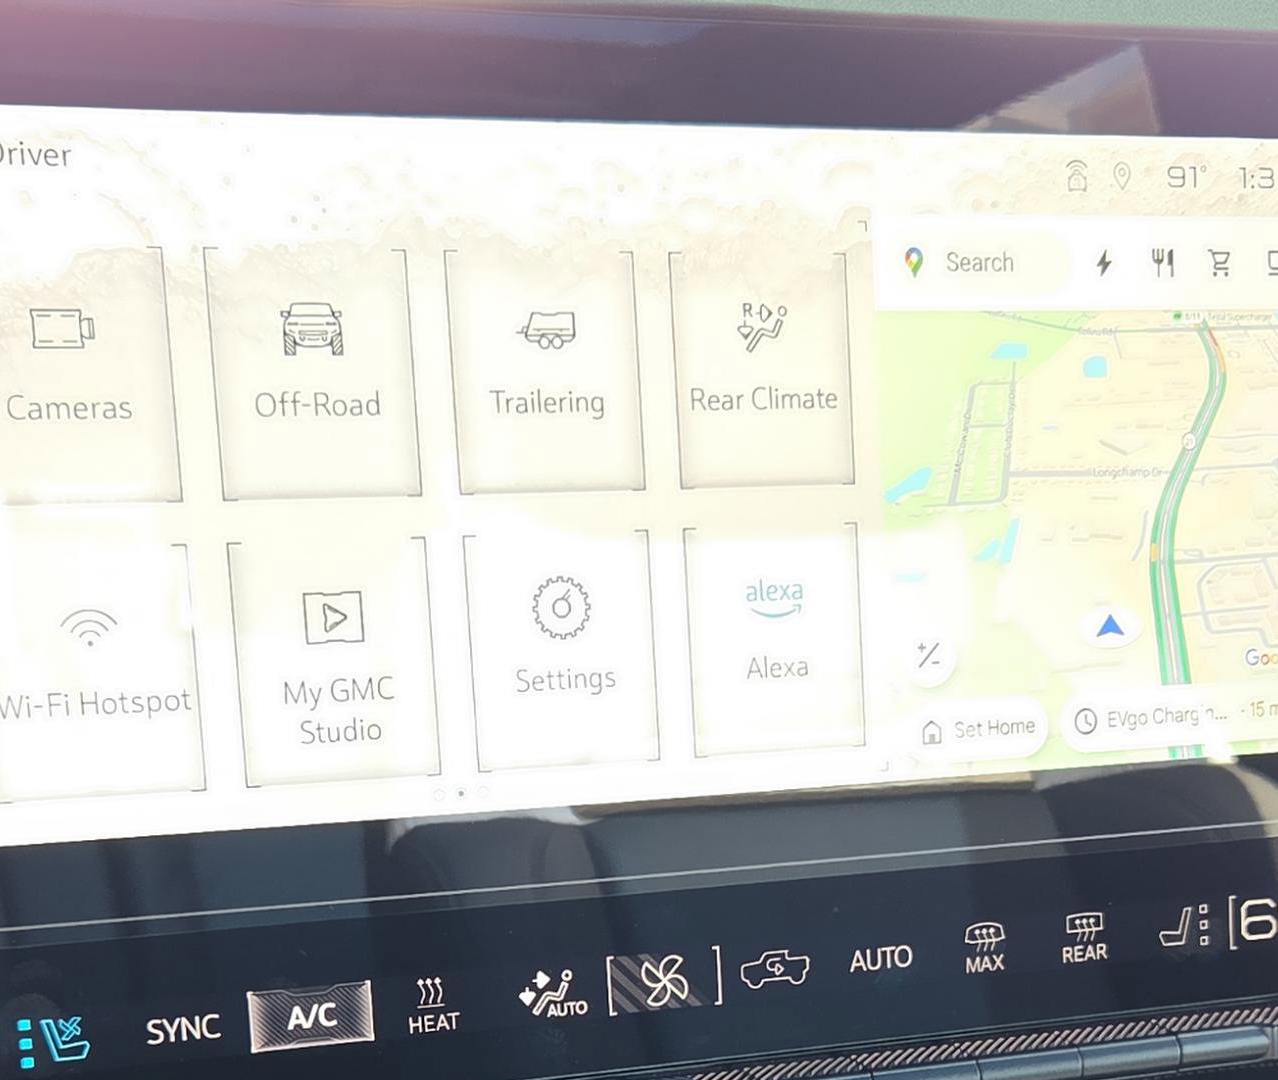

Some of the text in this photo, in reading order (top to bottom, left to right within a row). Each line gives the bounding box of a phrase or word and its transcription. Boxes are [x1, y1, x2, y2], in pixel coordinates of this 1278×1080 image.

[946, 251, 1015, 274] Search
[6, 394, 133, 421] Cameras
[255, 390, 381, 418] Off-Road
[488, 388, 605, 420] Trailering
[690, 385, 838, 411] Rear Climate
[1092, 467, 1150, 479] Longchamp
[745, 579, 804, 603] alexa
[746, 655, 809, 680] Alexa
[283, 675, 395, 711] My GMC
[516, 668, 616, 695] Settings
[79, 689, 192, 719] Hotspot
[1107, 710, 1149, 731] EVgo
[1250, 701, 1265, 719] 15
[300, 718, 382, 745] Studio
[955, 719, 1036, 739] Set Home
[849, 944, 913, 973] AUTO
[965, 952, 1005, 974] MAX
[1062, 939, 1108, 964] REAR
[286, 1001, 338, 1031] A/C
[408, 1011, 461, 1035] HEAT
[546, 1000, 589, 1019] AUTO
[146, 1013, 222, 1045] SYNC
